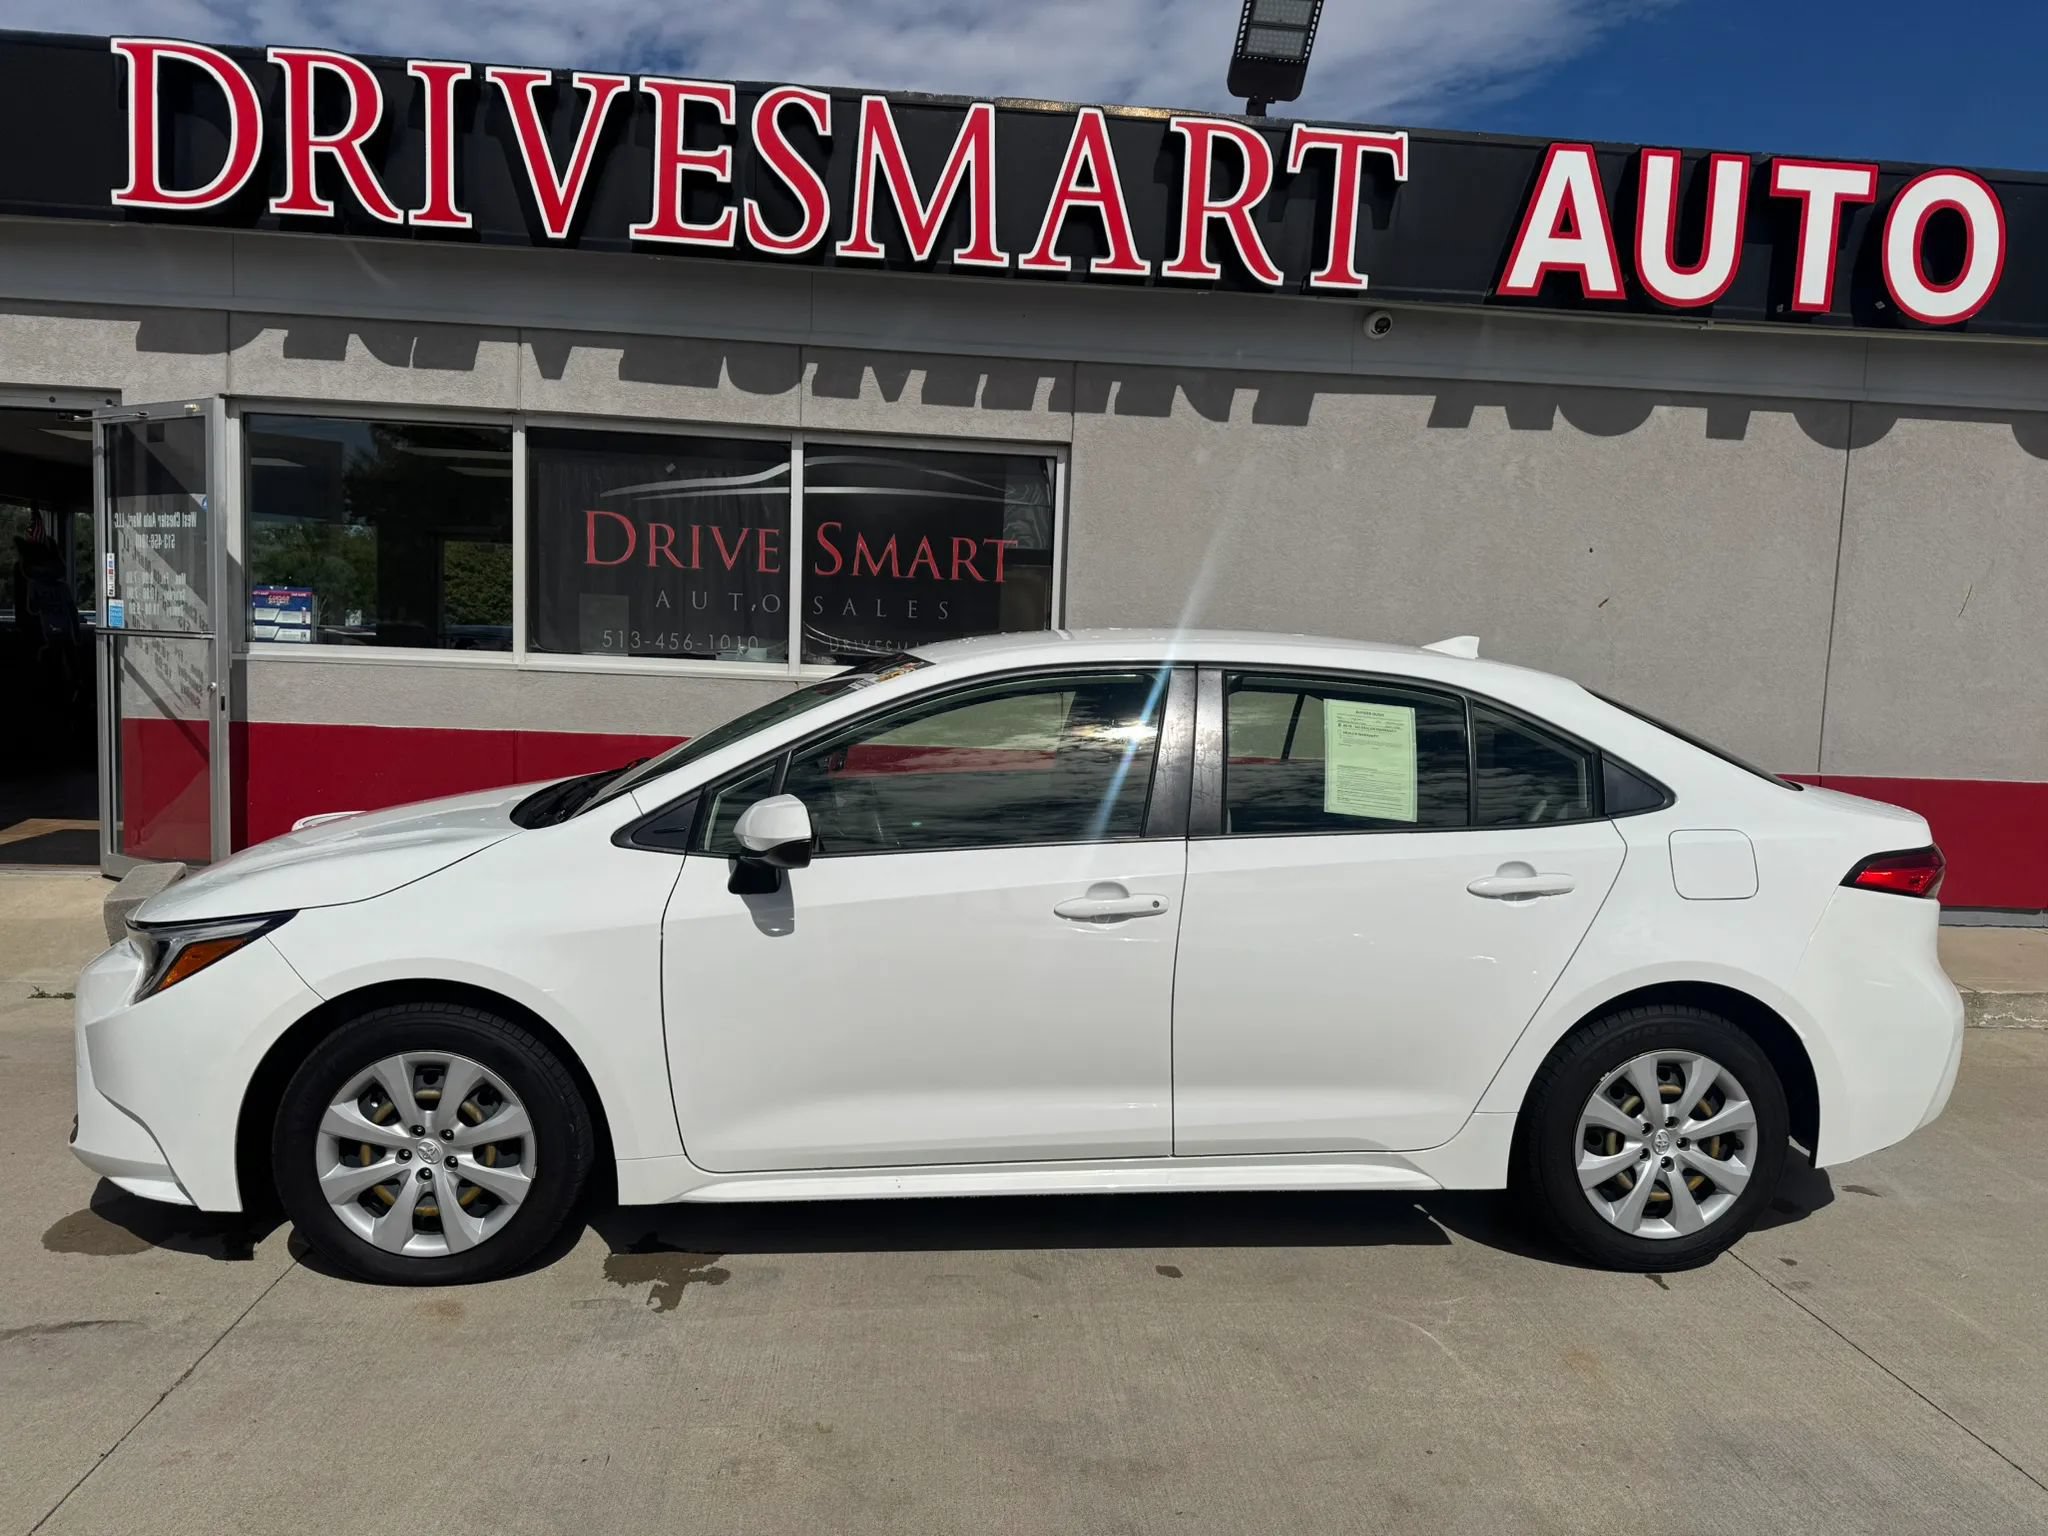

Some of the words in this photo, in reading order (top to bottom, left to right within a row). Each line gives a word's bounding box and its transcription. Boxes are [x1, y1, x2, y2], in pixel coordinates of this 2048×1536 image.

[110, 36, 1409, 290] DRIVESMART
[1497, 141, 2006, 325] AUTO
[584, 510, 781, 574] DRIVE
[815, 521, 1019, 584] SMART
[655, 589, 782, 613] AUTO
[813, 595, 950, 620] SALES
[602, 629, 760, 652] 513-456-1010
[829, 637, 934, 652] DRIVESMA
